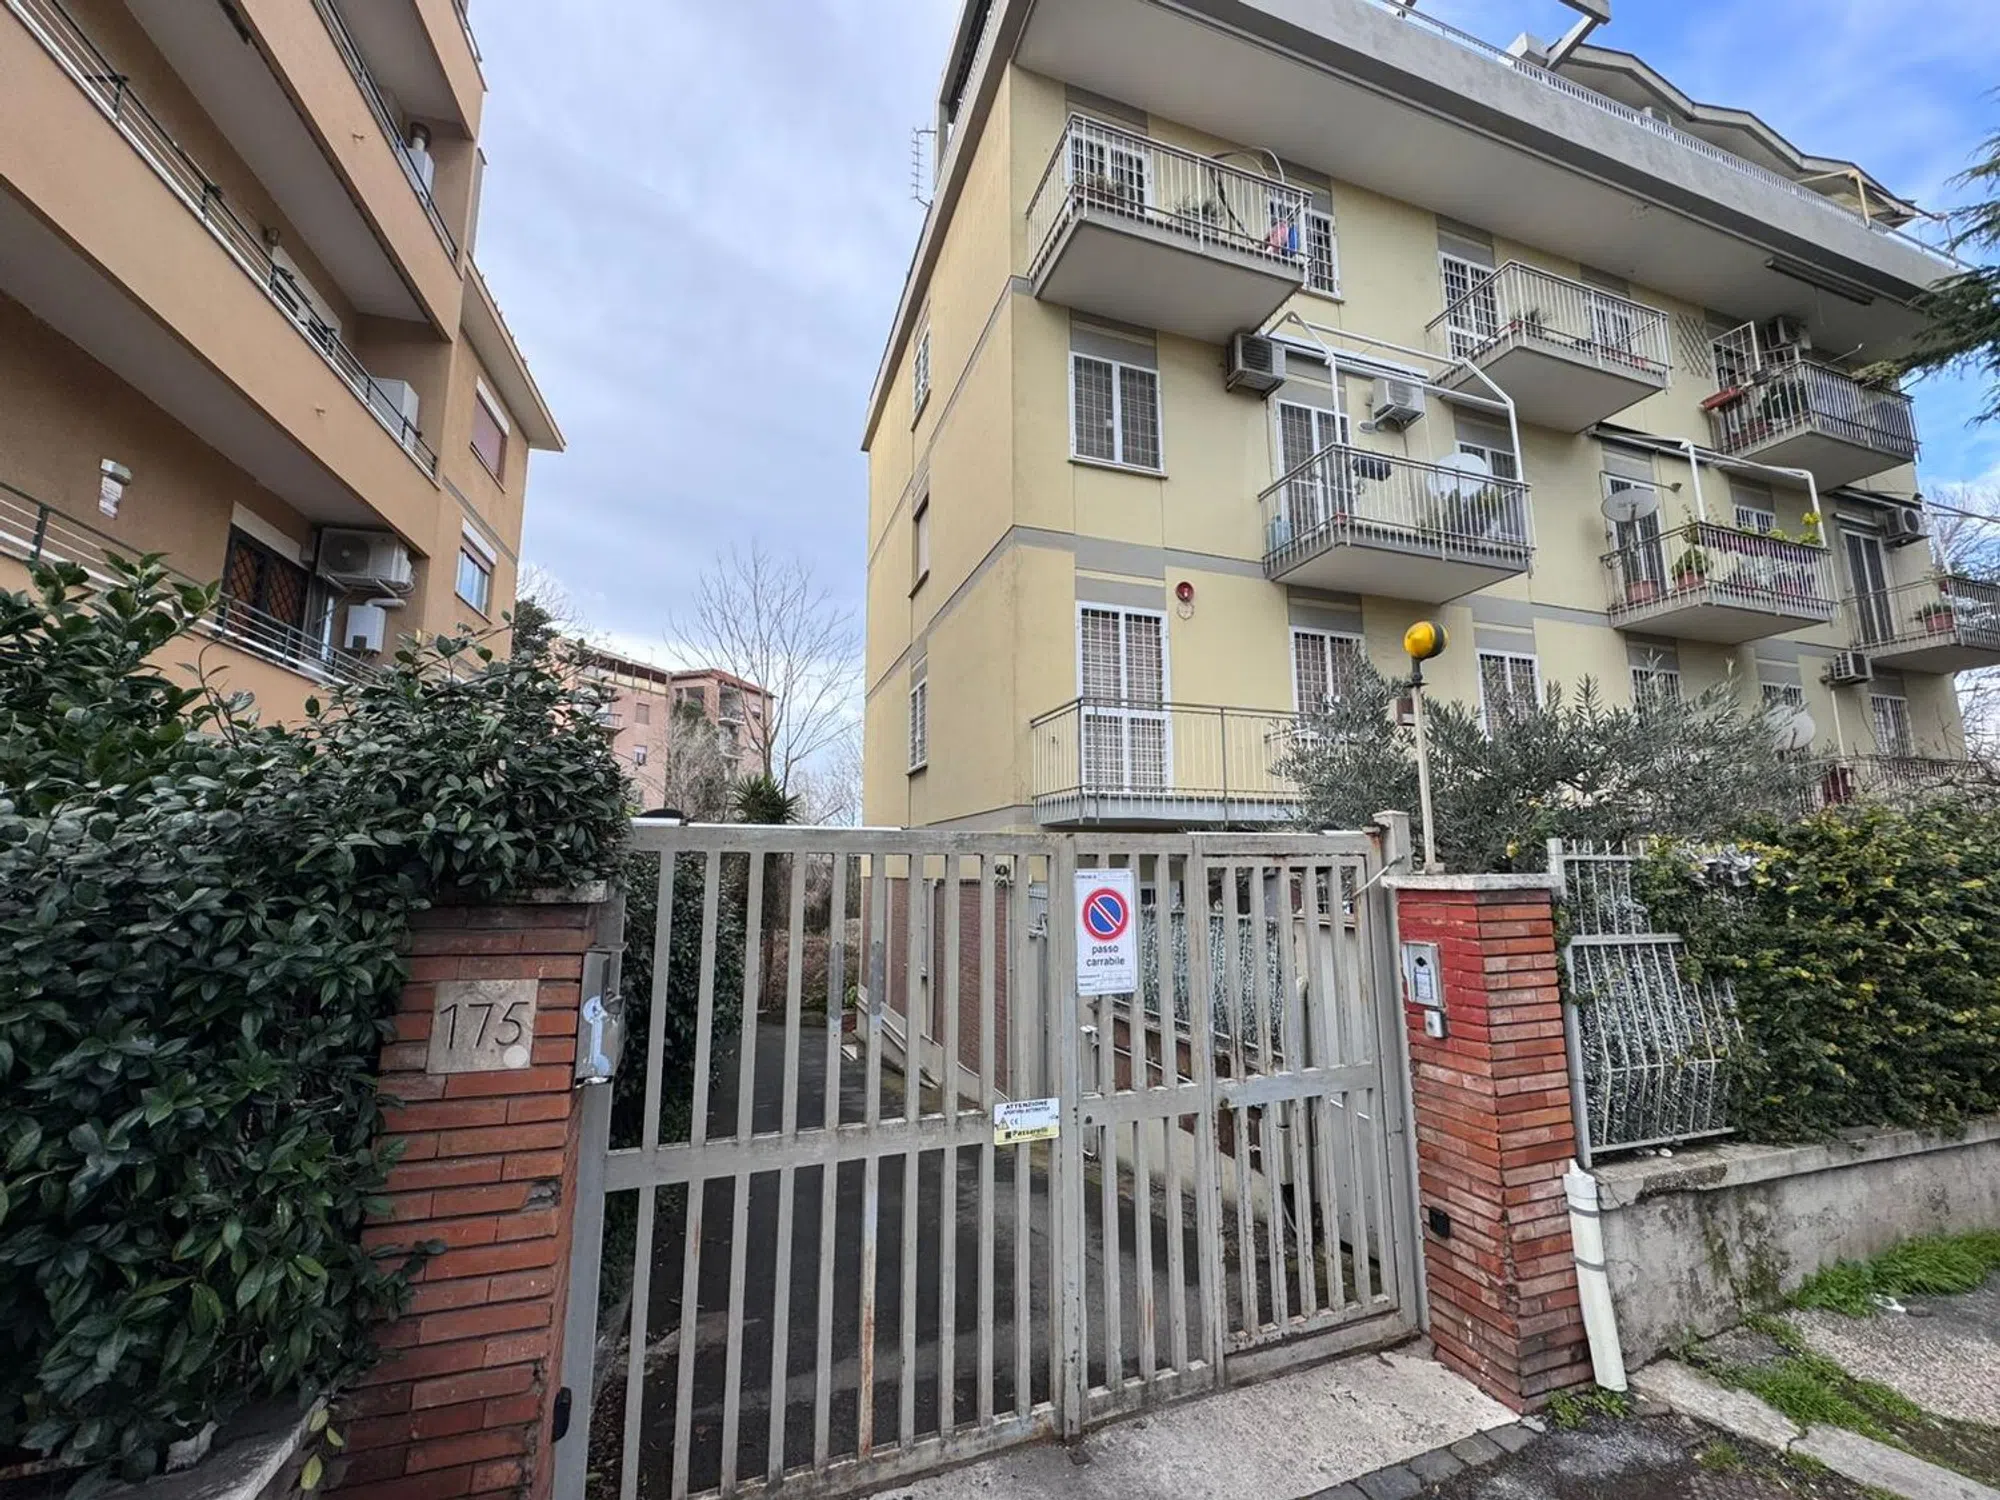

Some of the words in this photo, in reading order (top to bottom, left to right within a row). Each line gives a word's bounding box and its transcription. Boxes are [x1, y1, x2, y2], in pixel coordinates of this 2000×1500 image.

[1092, 945, 1119, 955] passo
[1086, 956, 1125, 967] carrabile
[439, 1001, 530, 1050] 175
[1006, 1101, 1047, 1109] ATTENZIONE
